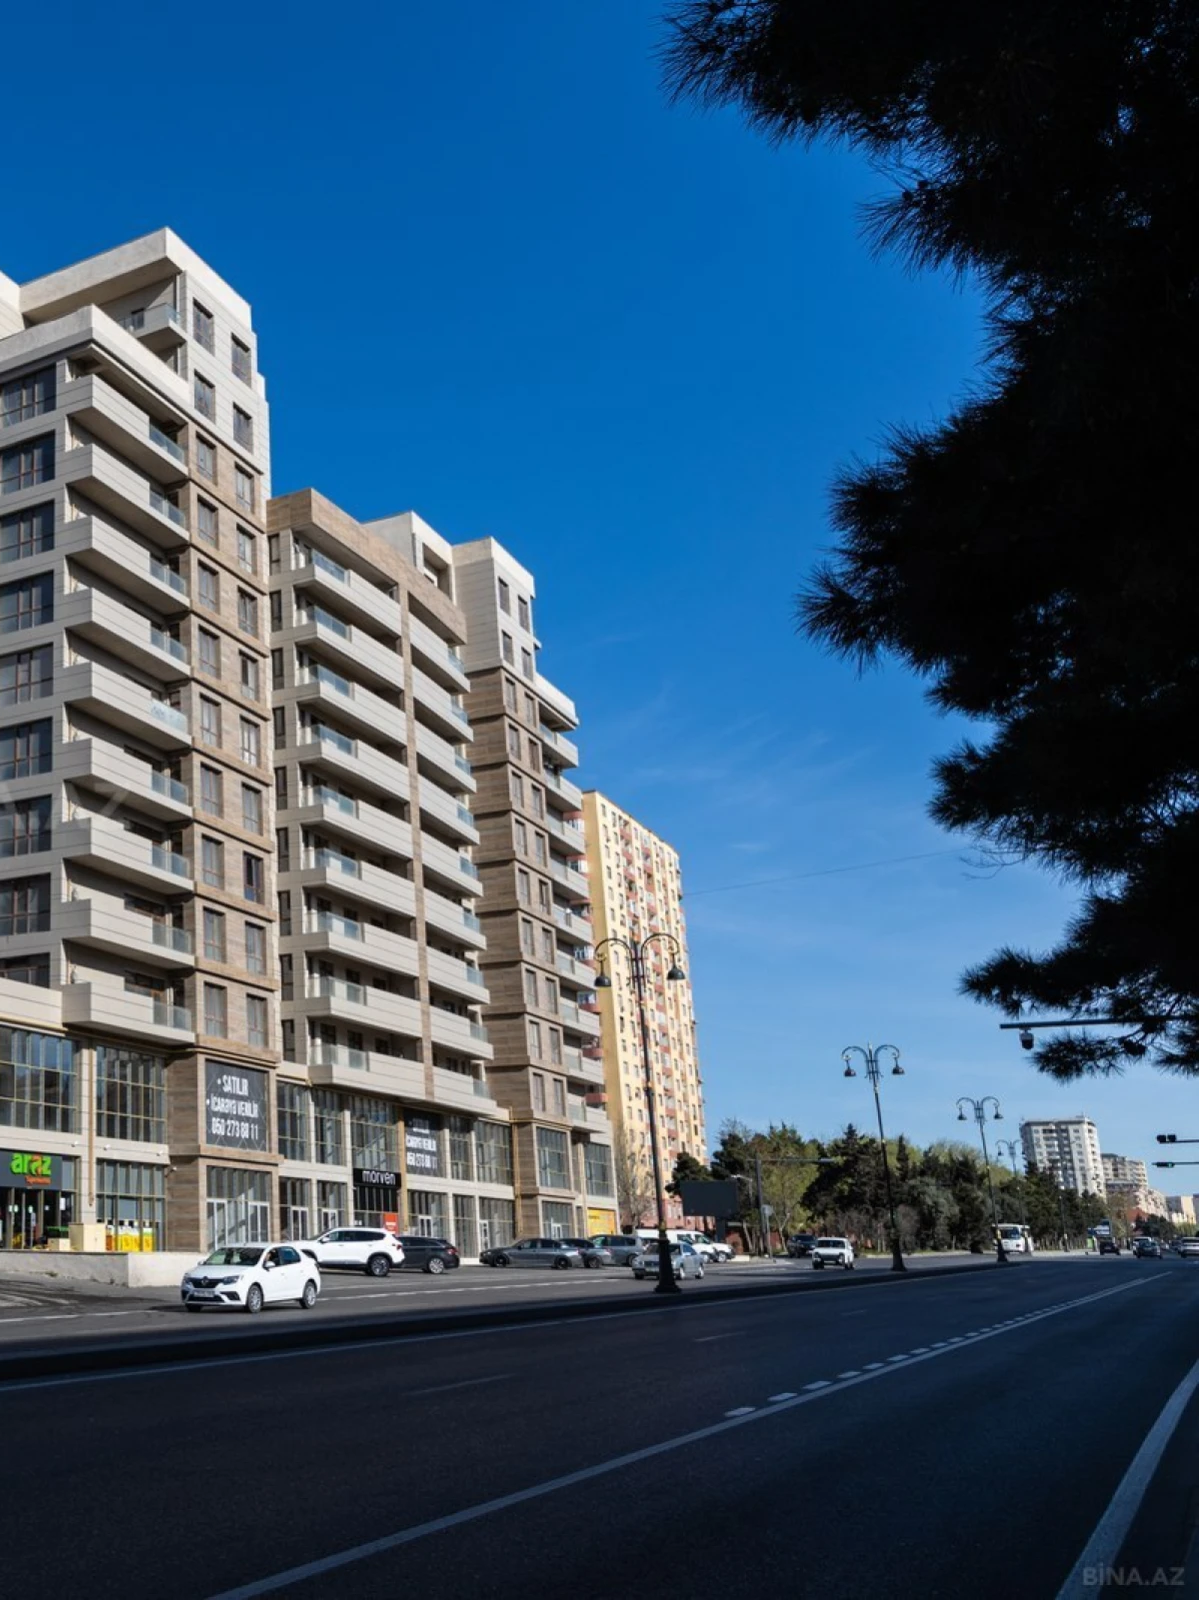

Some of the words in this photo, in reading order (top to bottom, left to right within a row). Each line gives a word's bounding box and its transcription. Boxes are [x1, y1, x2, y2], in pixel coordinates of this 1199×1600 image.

[227, 1119, 240, 1138] 273
[250, 1123, 258, 1140] 11
[10, 1152, 52, 1175] araz
